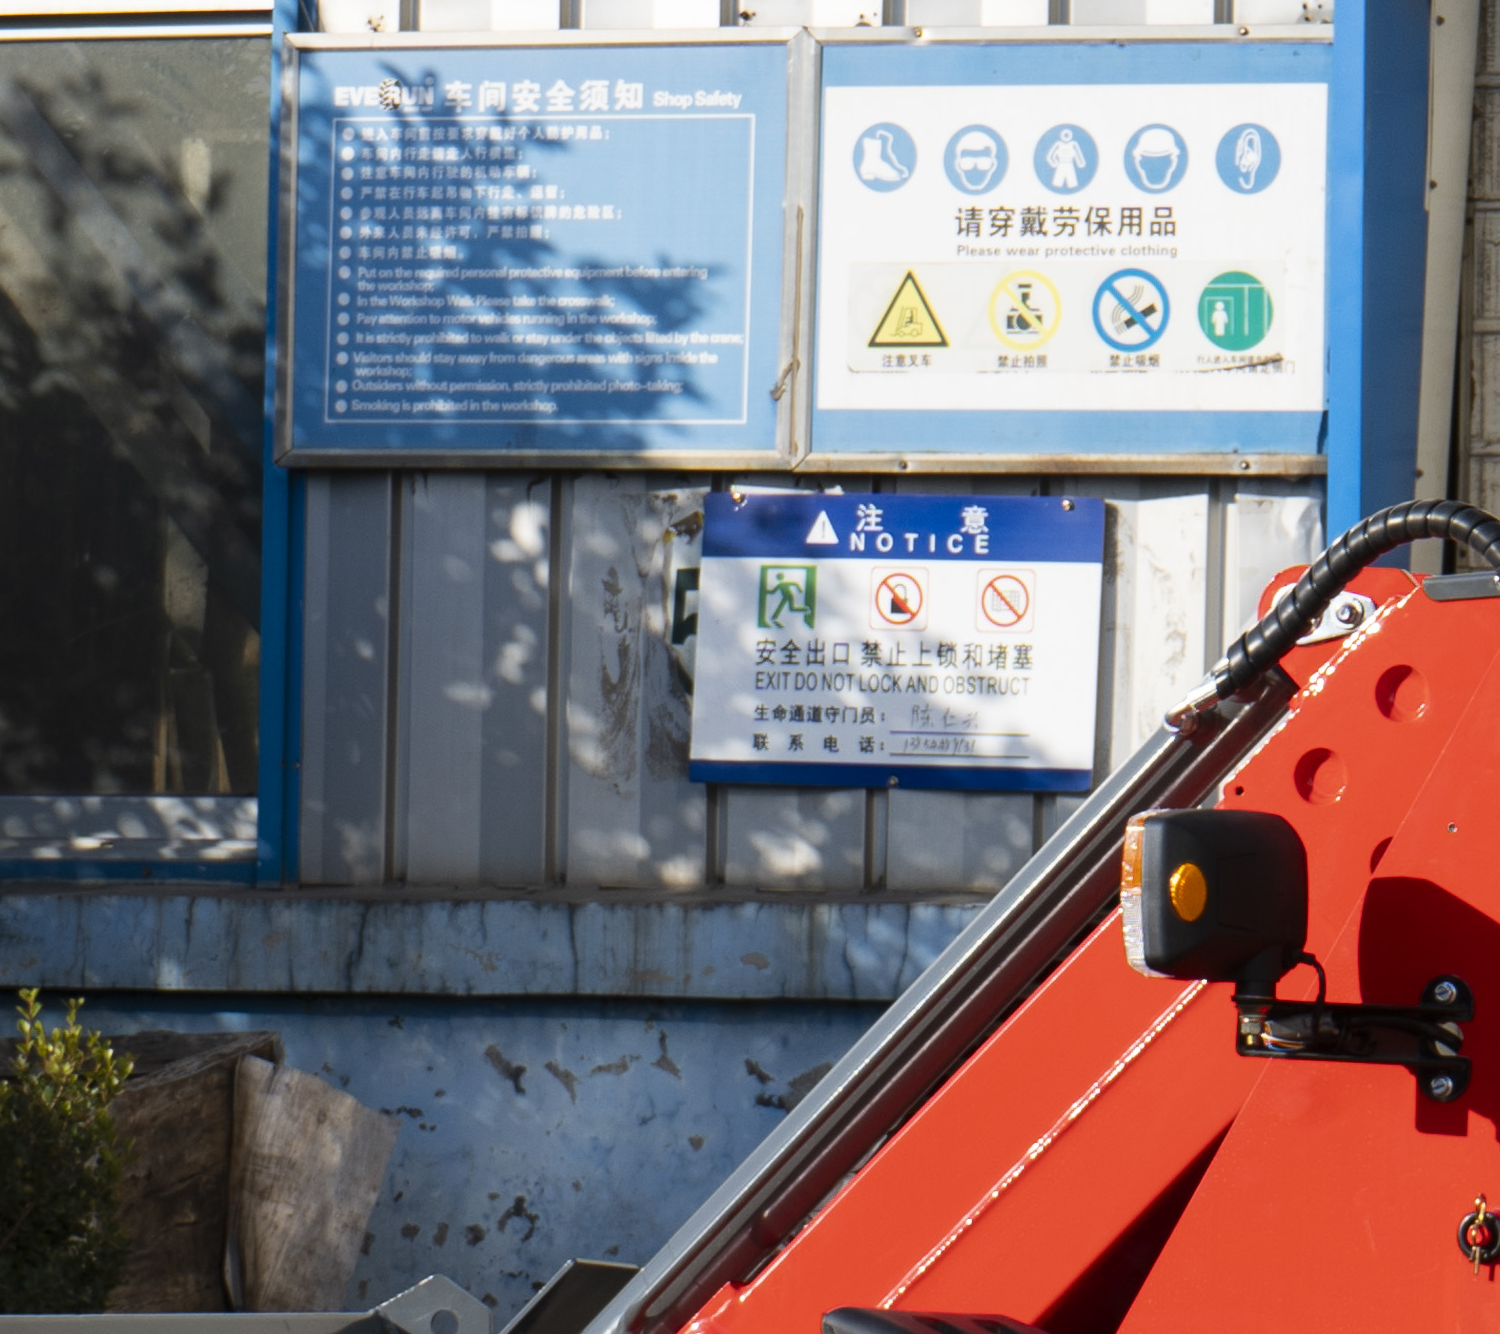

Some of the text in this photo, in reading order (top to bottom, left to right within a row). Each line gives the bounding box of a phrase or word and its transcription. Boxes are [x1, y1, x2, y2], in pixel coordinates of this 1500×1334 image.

[444, 79, 645, 113] 车间安全须知
[652, 88, 743, 110] Shop Safety
[955, 205, 1177, 237] 请穿戴劳保用品
[956, 244, 1178, 259] Please wear protective clothing
[882, 354, 932, 368] 注意叉车
[997, 354, 1048, 368] 禁止拍照
[1109, 353, 1160, 367] 禁止吸烟
[856, 503, 989, 534] 注意
[850, 532, 990, 554] NOTICE
[755, 638, 1033, 670] 安全出口 禁止上锁和堵塞
[755, 671, 1031, 695] EXIT DO NOT LOCK AND OBSTRUCT
[754, 704, 886, 724] 生命通道守门员：
